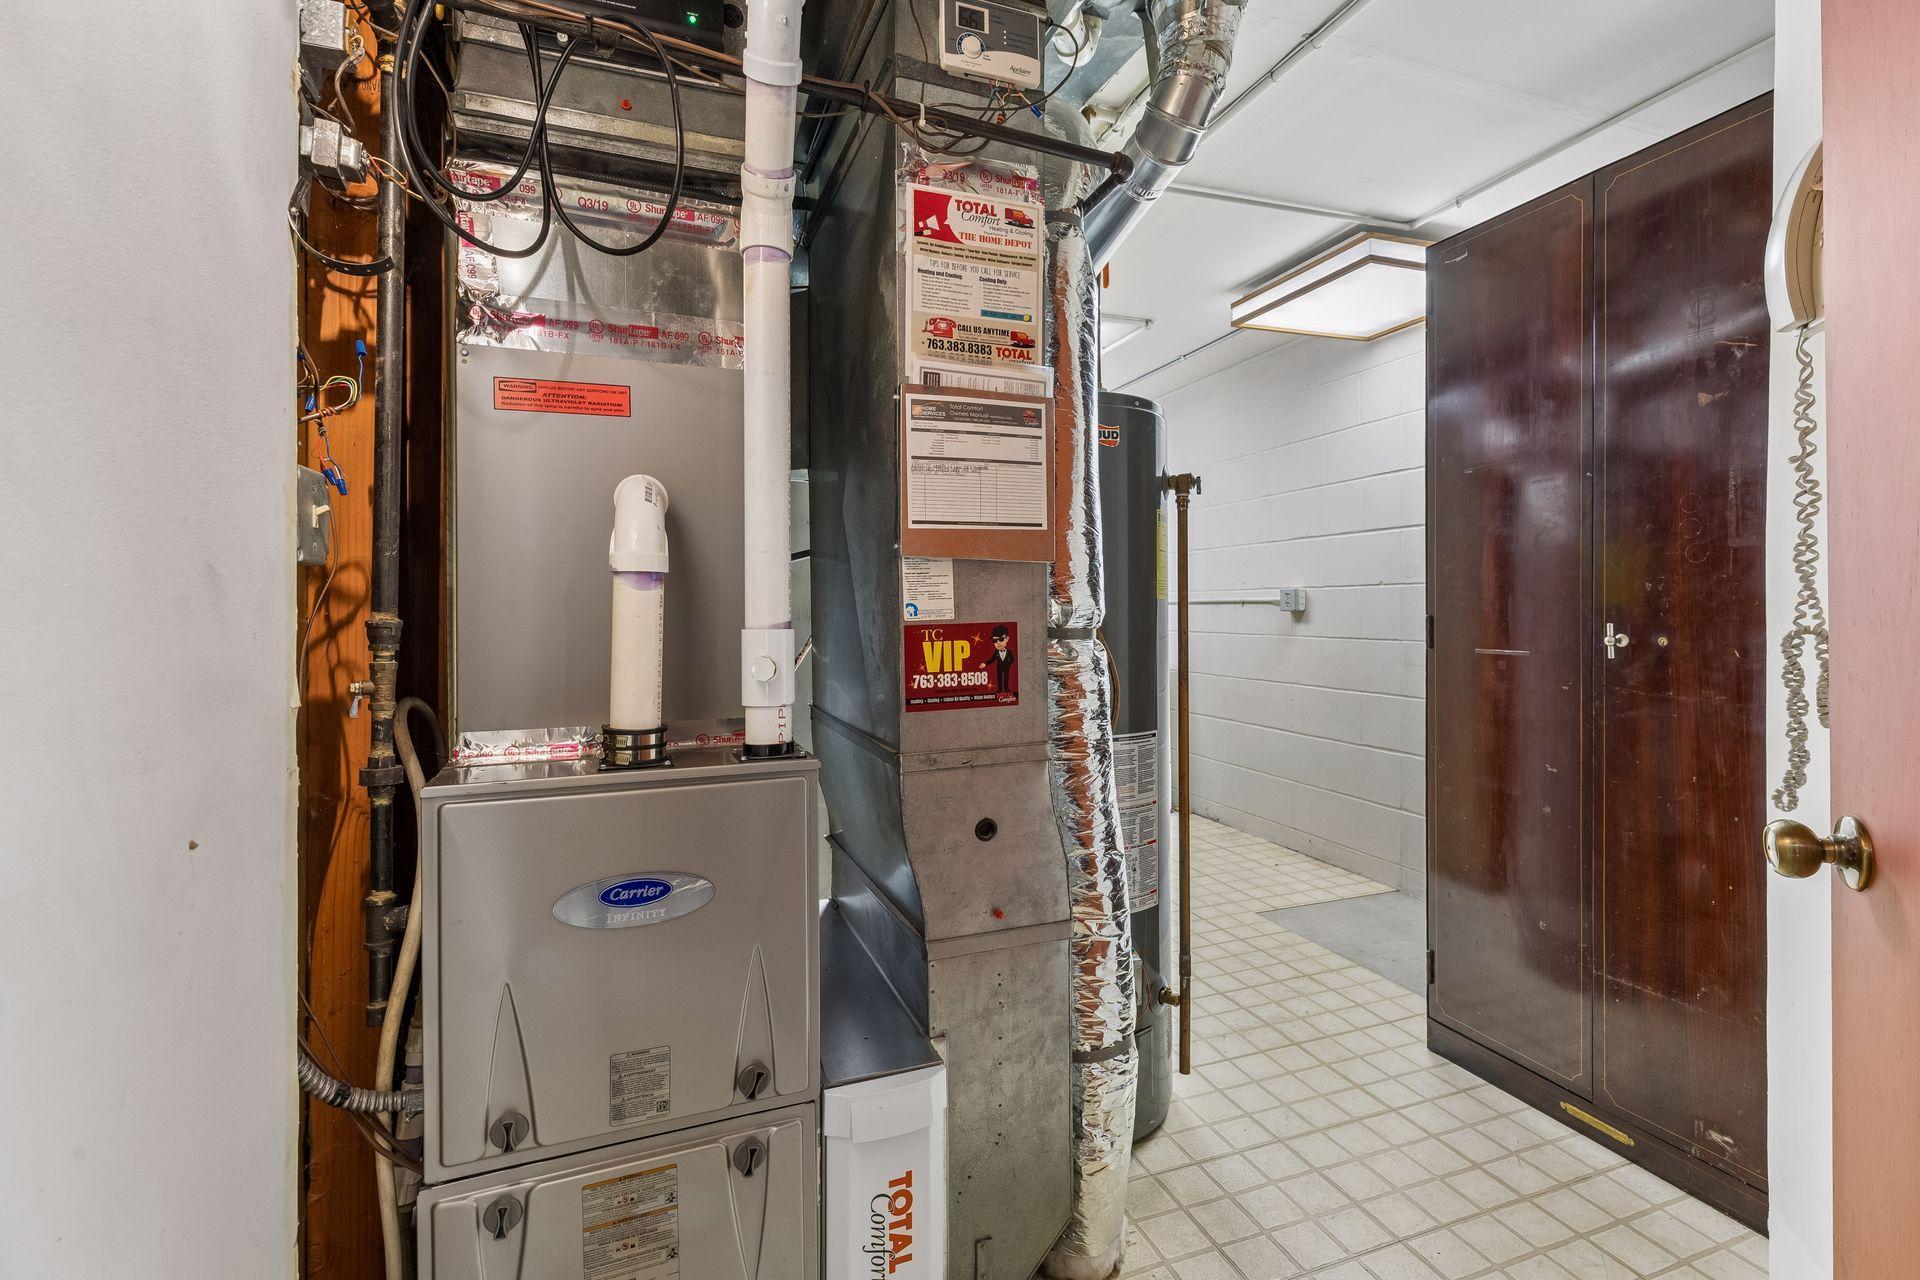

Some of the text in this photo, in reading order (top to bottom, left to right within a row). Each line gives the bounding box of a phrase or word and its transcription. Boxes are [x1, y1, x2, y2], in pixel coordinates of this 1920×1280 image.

[578, 196, 609, 212] Q3/19
[645, 204, 686, 219] Shurpe
[955, 199, 998, 217] TOTAL
[961, 211, 1001, 227] Comfort
[989, 225, 1009, 235] Heating
[1015, 228, 1034, 238] Cooling
[959, 231, 1033, 249] THE HOME DEPOT
[918, 268, 935, 276] Heating
[929, 259, 940, 269] TIPS
[941, 260, 950, 270] FOR
[951, 261, 968, 272] BEFORE
[970, 264, 979, 274] YOU
[980, 266, 992, 275] CALL
[993, 267, 1002, 276] FOR
[979, 276, 996, 284] Cooling
[661, 330, 673, 340] AF
[674, 332, 690, 342] 099
[957, 323, 1010, 337] CALL US ANYTIME
[927, 338, 992, 356] 763.383.8383
[995, 347, 1032, 361] TOTAL
[921, 628, 944, 641] TC
[922, 640, 971, 673] VIP
[609, 885, 664, 901] Carrier
[606, 908, 667, 924] INFINITY
[888, 1169, 914, 1275] TOTAL
